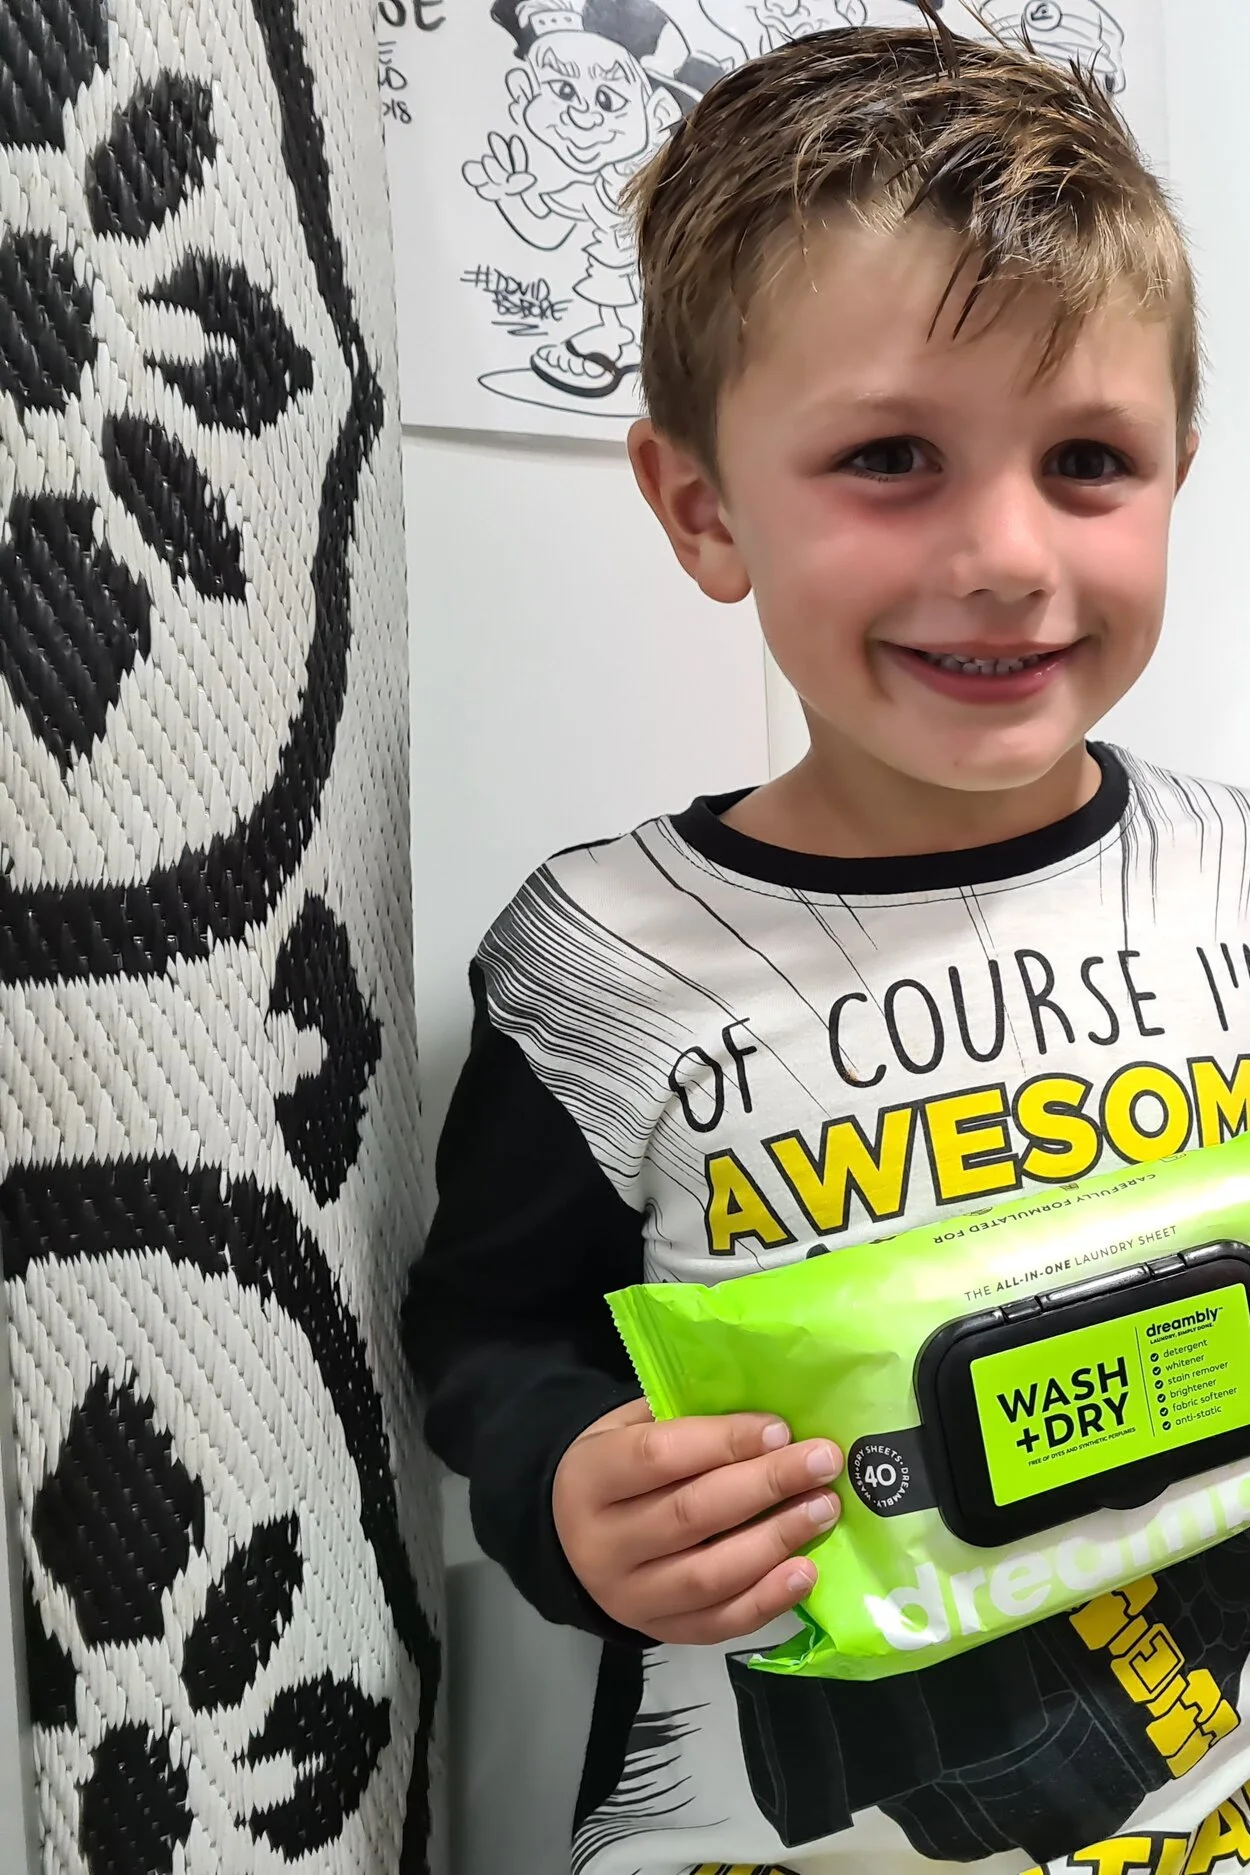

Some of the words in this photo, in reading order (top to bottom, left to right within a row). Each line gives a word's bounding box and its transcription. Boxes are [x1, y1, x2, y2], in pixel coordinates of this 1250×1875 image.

[668, 1017, 757, 1133] OF
[828, 949, 1166, 1088] COURSE
[1077, 1173, 1156, 1203] CAREFULLY
[969, 1200, 1072, 1232] FORMULATED
[934, 1230, 965, 1244] FOR
[964, 1286, 992, 1302] THE
[996, 1259, 1072, 1292] ALL-IN-ONE
[1074, 1240, 1134, 1266] LAUNDRY
[1138, 1225, 1177, 1246] SHEET
[1146, 1307, 1219, 1338] dreambly
[1163, 1339, 1208, 1358] detergent
[1165, 1354, 1204, 1372] whitener
[1168, 1371, 1190, 1385] stain
[1192, 1361, 1228, 1377] remover
[996, 1356, 1129, 1424] WASH
[1170, 1379, 1217, 1399] brightener
[1172, 1398, 1199, 1412] fabric
[1200, 1387, 1237, 1403] softener
[1175, 1405, 1222, 1426] anti-static
[865, 1445, 903, 1463] SHEETS
[1028, 1459, 1042, 1467] FREE
[1051, 1450, 1066, 1459] DYES
[1066, 1446, 1078, 1454] AND
[1078, 1436, 1108, 1450] SYNTHETIC
[1108, 1427, 1137, 1440] PERFUMES
[864, 1463, 897, 1488] 40
[877, 1467, 910, 1508] DREAMBLY
